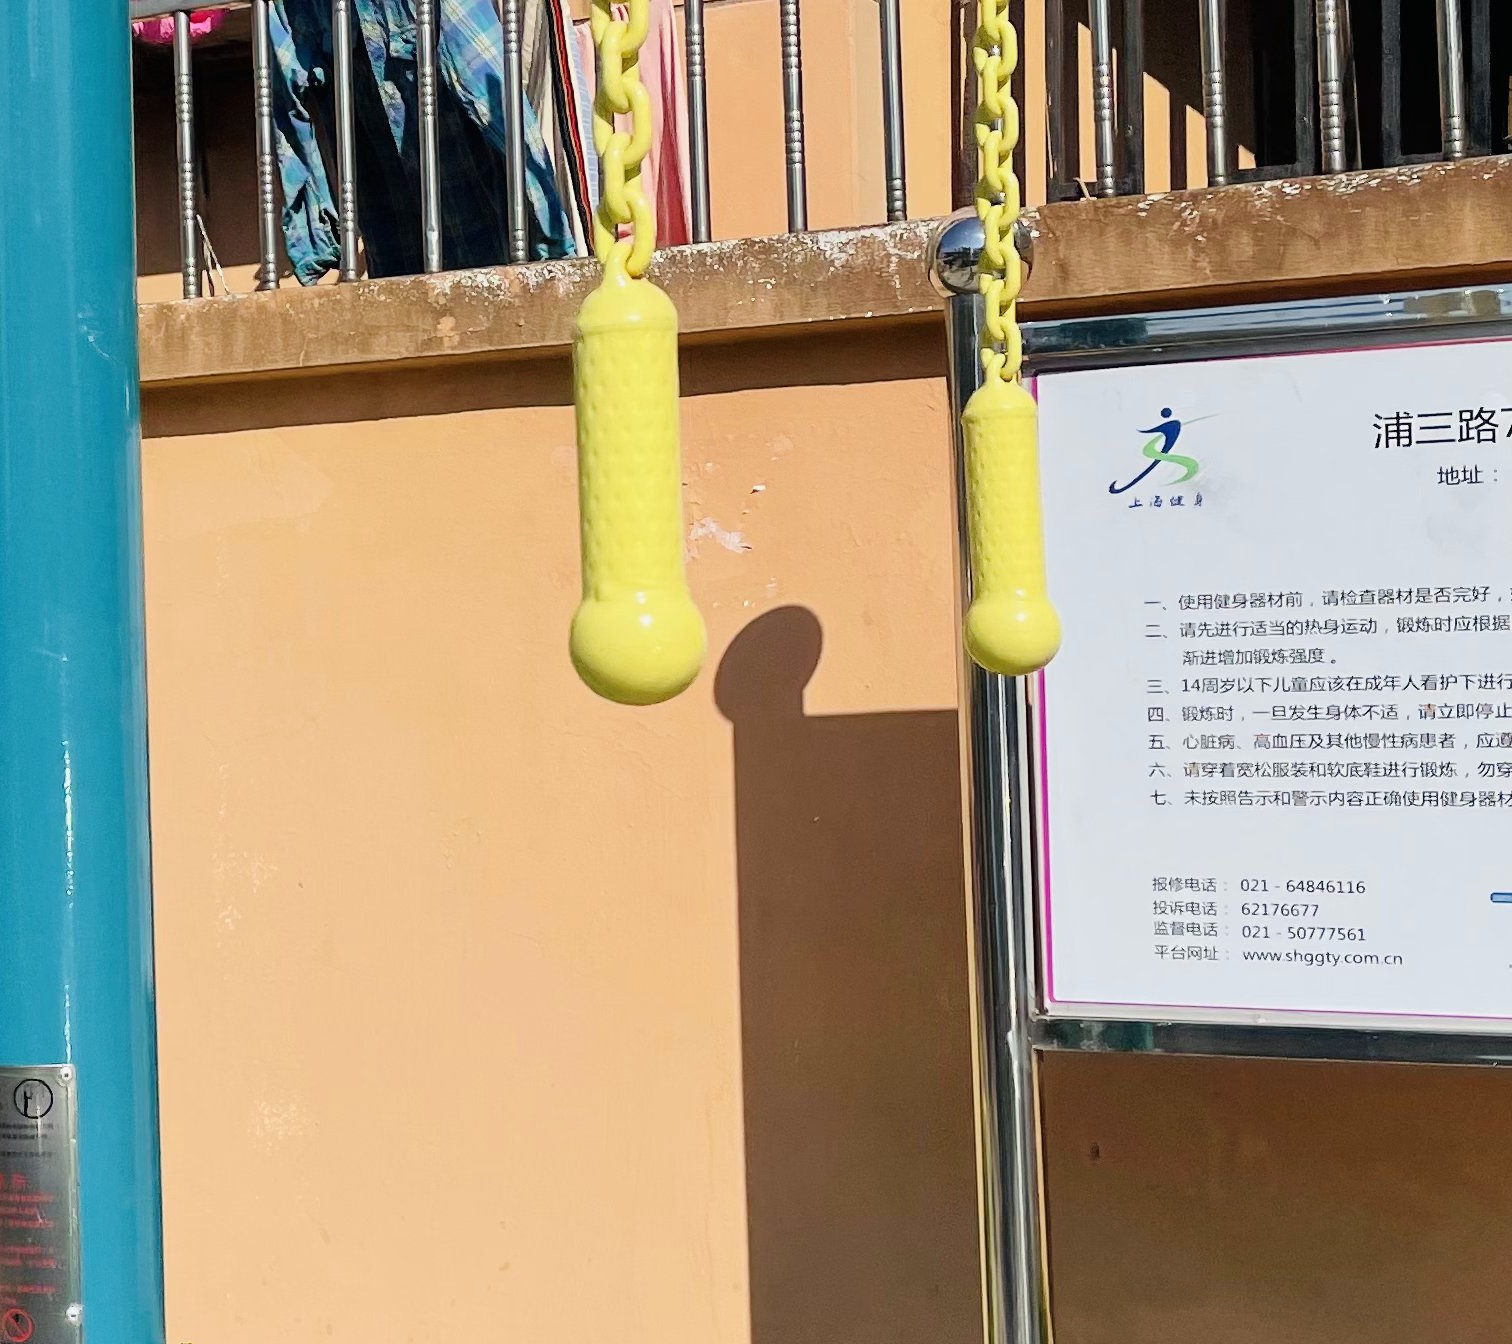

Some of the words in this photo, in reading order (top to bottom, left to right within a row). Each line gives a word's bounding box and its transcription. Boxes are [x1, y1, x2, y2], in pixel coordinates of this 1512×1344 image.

[1240, 878, 1269, 892] 021
[1286, 879, 1366, 894] 64846116
[1241, 902, 1319, 917] 62176677
[1242, 925, 1270, 939] 021
[1287, 926, 1367, 941] 50777561
[1243, 949, 1403, 966] www.shggty.com.cn
